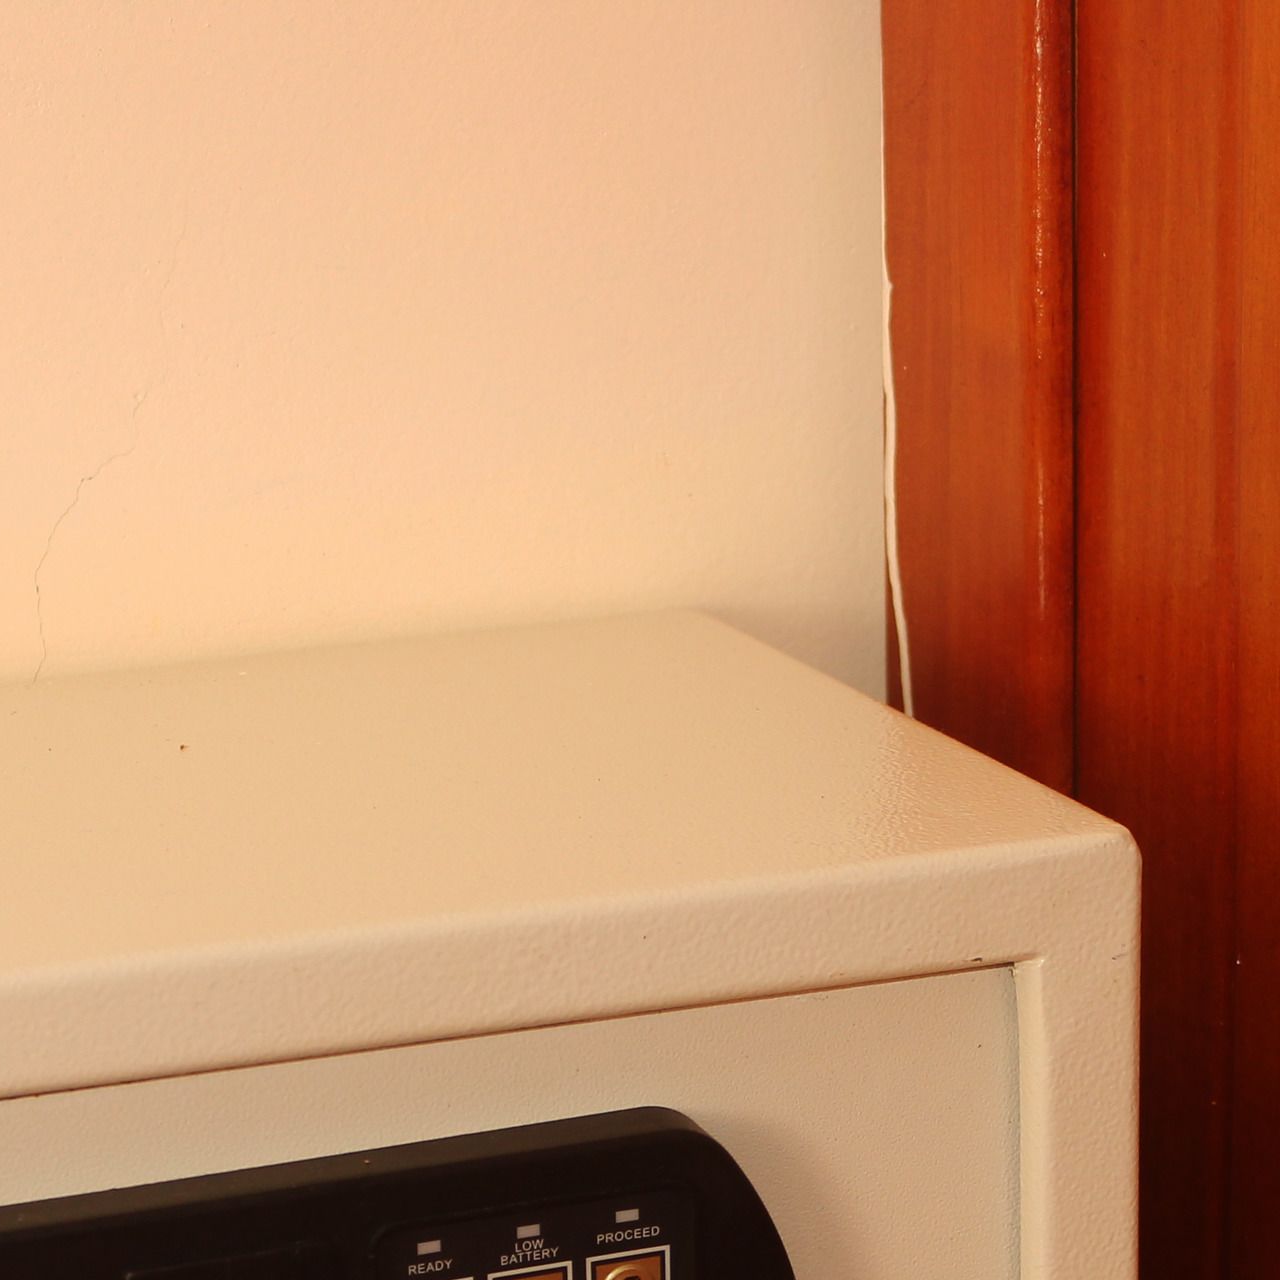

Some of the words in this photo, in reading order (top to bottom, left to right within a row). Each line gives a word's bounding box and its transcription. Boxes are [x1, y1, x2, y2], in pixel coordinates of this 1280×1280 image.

[596, 1226, 661, 1245] PROCEED
[515, 1239, 545, 1253] LOW
[500, 1247, 560, 1266] BATTERY
[408, 1259, 453, 1276] READY
